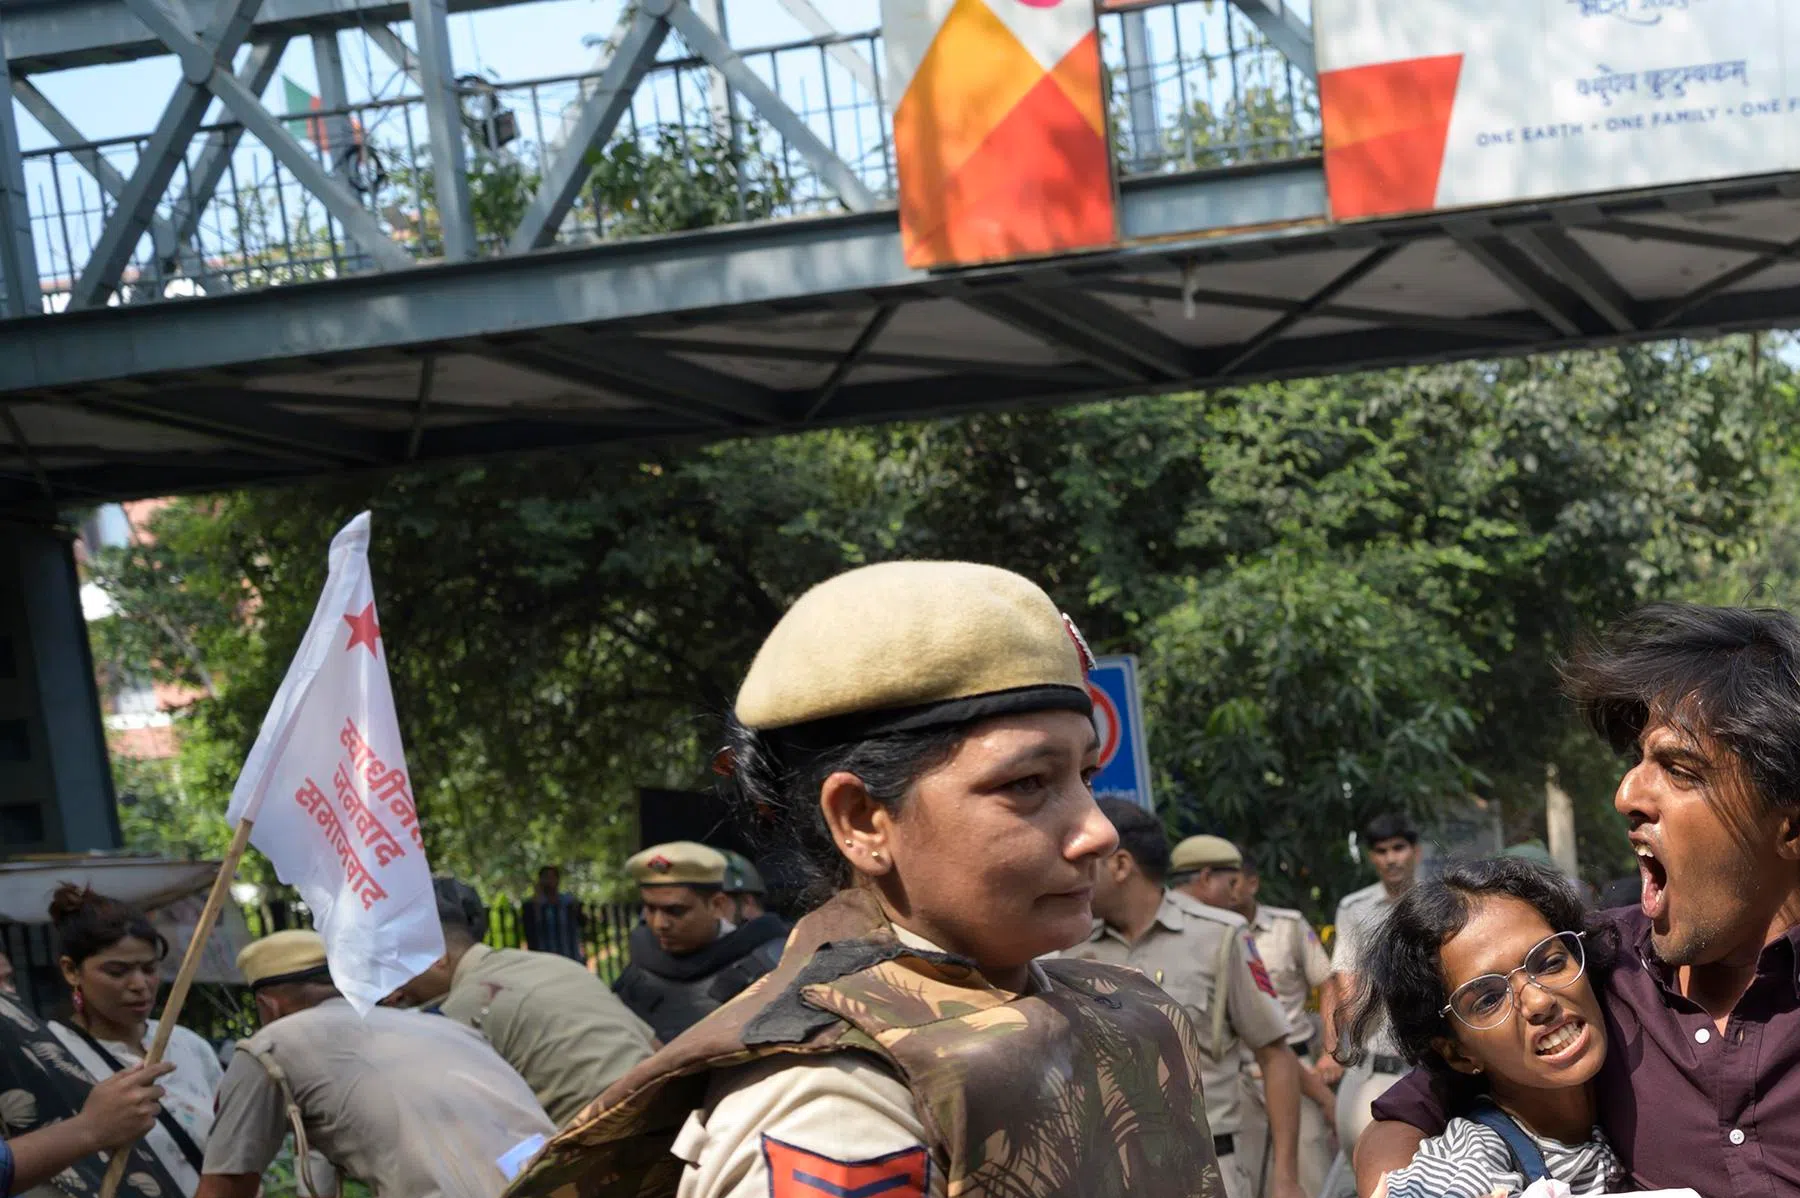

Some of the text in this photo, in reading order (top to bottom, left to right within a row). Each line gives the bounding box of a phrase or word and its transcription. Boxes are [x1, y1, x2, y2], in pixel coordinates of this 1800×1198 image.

[1476, 128, 1515, 147] ONE
[1521, 123, 1584, 143] EARTH
[1605, 113, 1644, 132] ONE
[1651, 105, 1718, 127] FAMILY
[1740, 99, 1780, 118] ONE
[295, 777, 388, 912] समाजवाद
[333, 761, 406, 868] जनवाद
